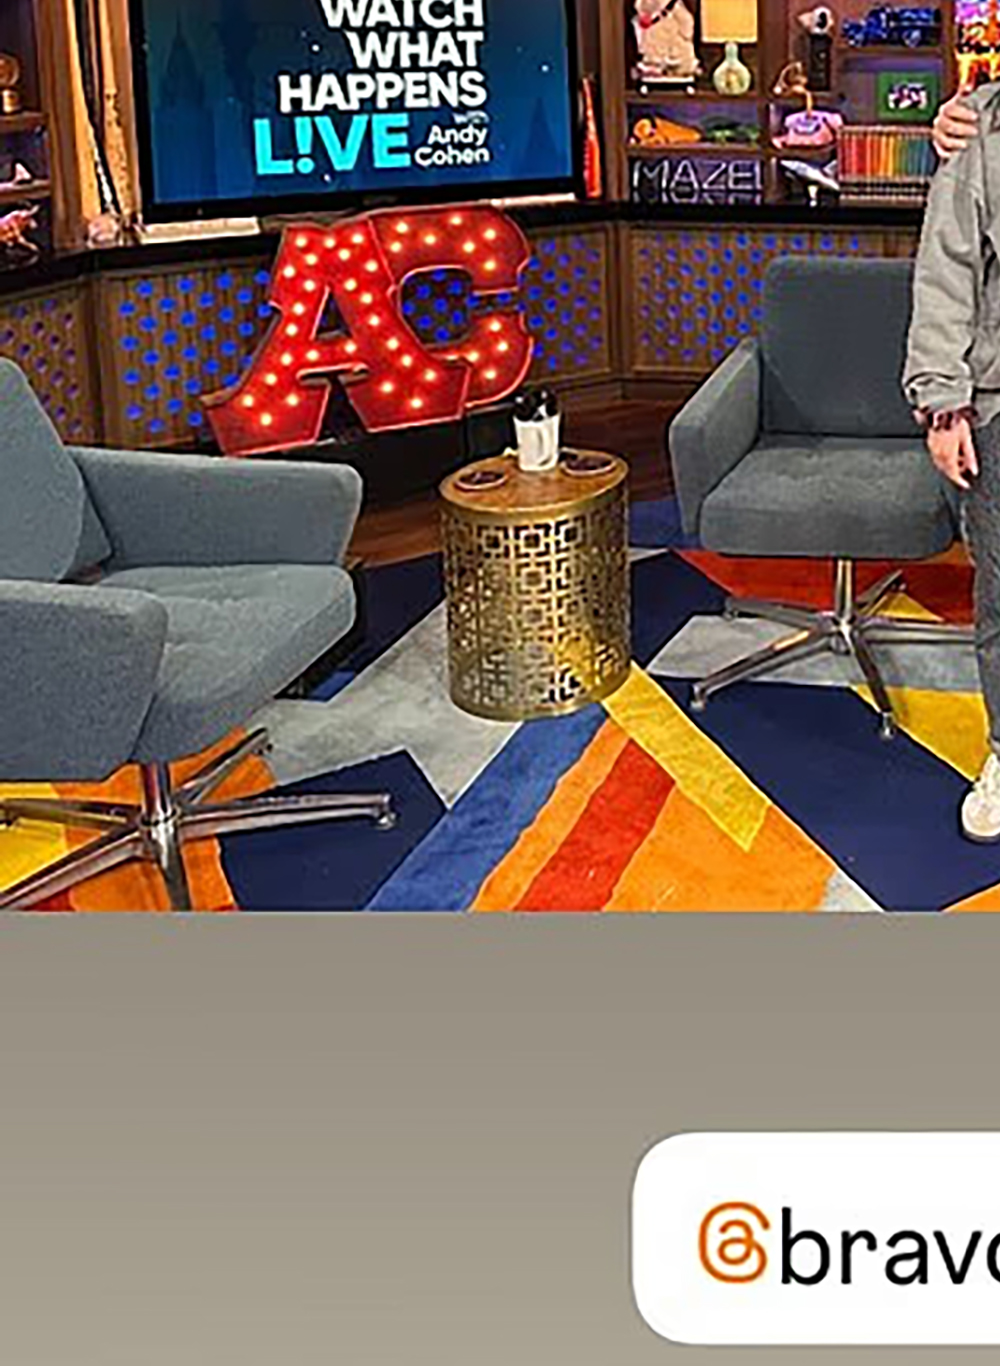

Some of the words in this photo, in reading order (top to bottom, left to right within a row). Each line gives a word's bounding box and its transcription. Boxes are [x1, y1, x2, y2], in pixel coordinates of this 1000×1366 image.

[346, 31, 485, 69] WHAT
[277, 70, 488, 114] HAPPENS
[427, 124, 488, 146] Andy
[414, 144, 490, 167] Cohen
[205, 204, 535, 457] AC
